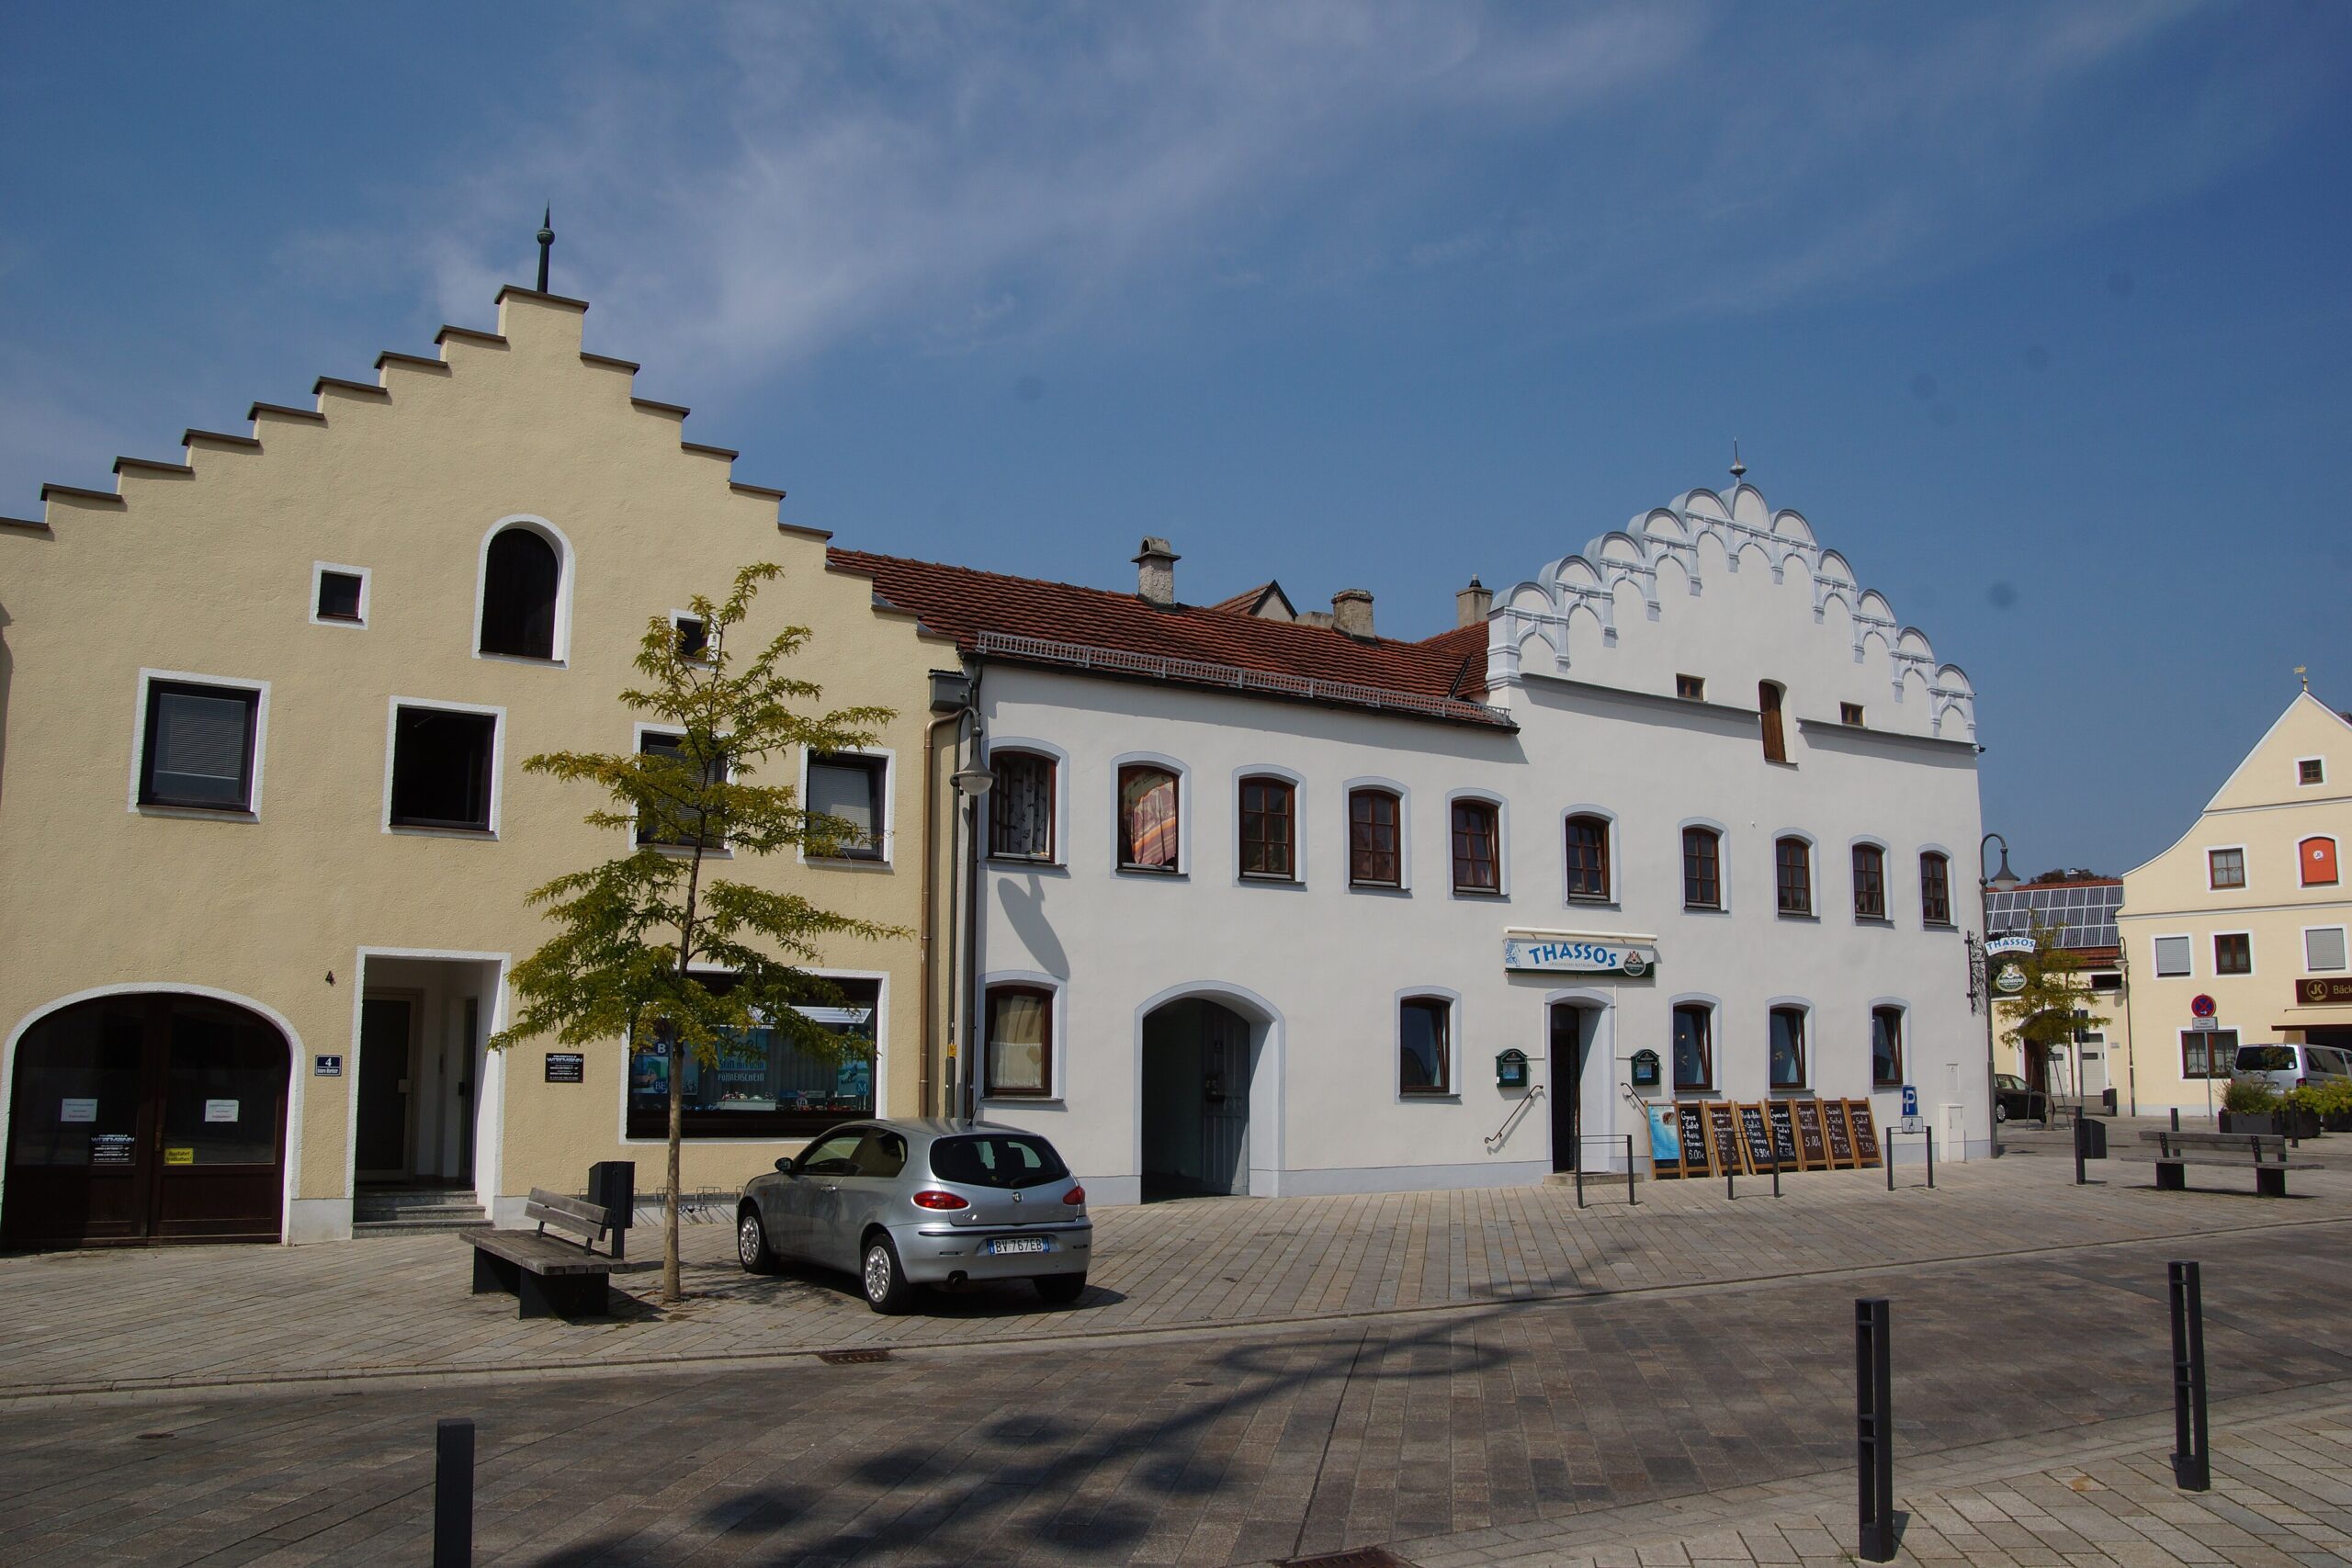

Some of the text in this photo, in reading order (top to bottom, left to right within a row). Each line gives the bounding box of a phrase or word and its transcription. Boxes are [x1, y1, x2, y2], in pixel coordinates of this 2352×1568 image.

[1986, 938, 2035, 950] THASSOS
[1528, 942, 1617, 967] THASSOS
[2311, 984, 2324, 995] JK
[657, 1043, 666, 1054] B
[324, 1057, 333, 1066] 4
[857, 1083, 867, 1093] M
[1905, 1089, 1916, 1112] P
[995, 1237, 1043, 1253] BV 767EB
